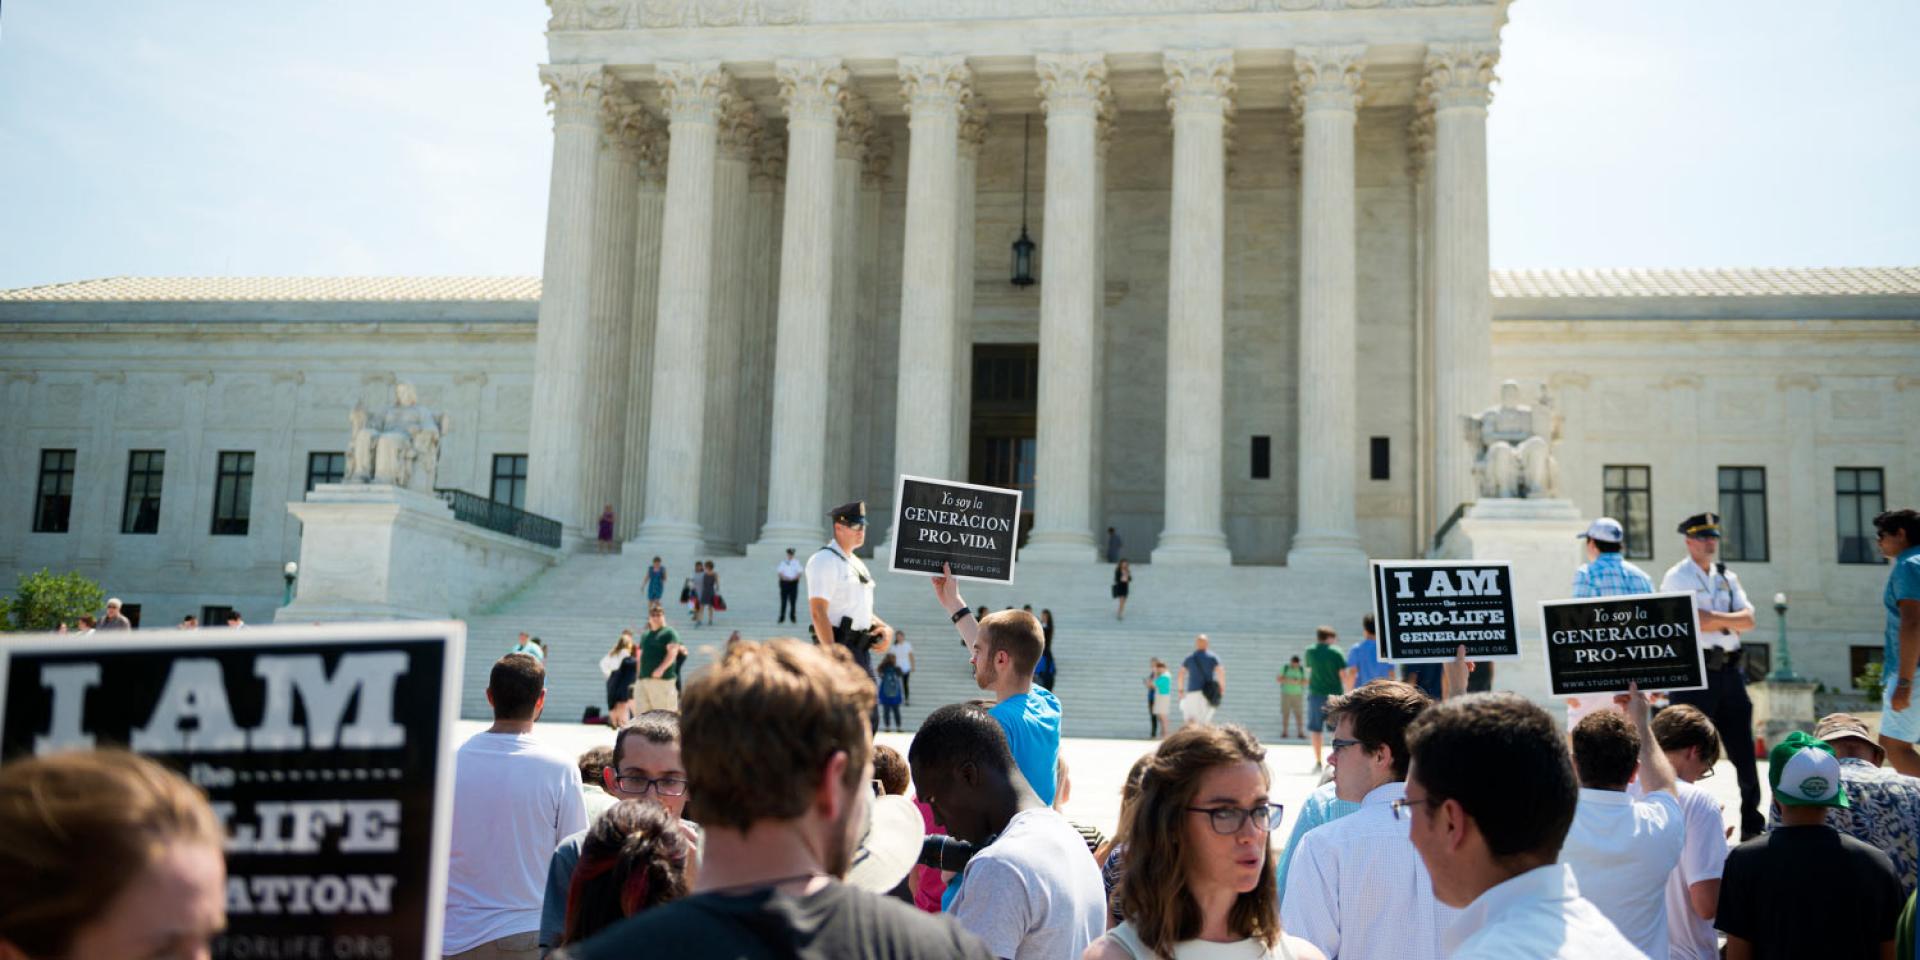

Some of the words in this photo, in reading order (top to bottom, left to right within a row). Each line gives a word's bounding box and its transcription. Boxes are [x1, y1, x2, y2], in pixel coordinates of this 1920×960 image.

[942, 491, 953, 505] Yo
[956, 497, 971, 512] soy
[973, 496, 983, 509] la
[904, 507, 1011, 532] GENERACION
[918, 528, 996, 550] PRO-VIDA
[1394, 572, 1415, 599] I
[1425, 570, 1501, 596] AM
[1397, 610, 1505, 626] PRO-LIFE
[1594, 608, 1609, 623] Yo
[1612, 611, 1632, 625] soy
[1635, 606, 1648, 620] la
[1399, 630, 1506, 643] GENERATION
[1552, 622, 1689, 645] GENERACION
[1575, 644, 1678, 663] PRO-VIDA
[34, 663, 102, 756] I
[130, 650, 410, 753] AM
[222, 801, 400, 853] LIFE
[225, 875, 396, 913] ATION
